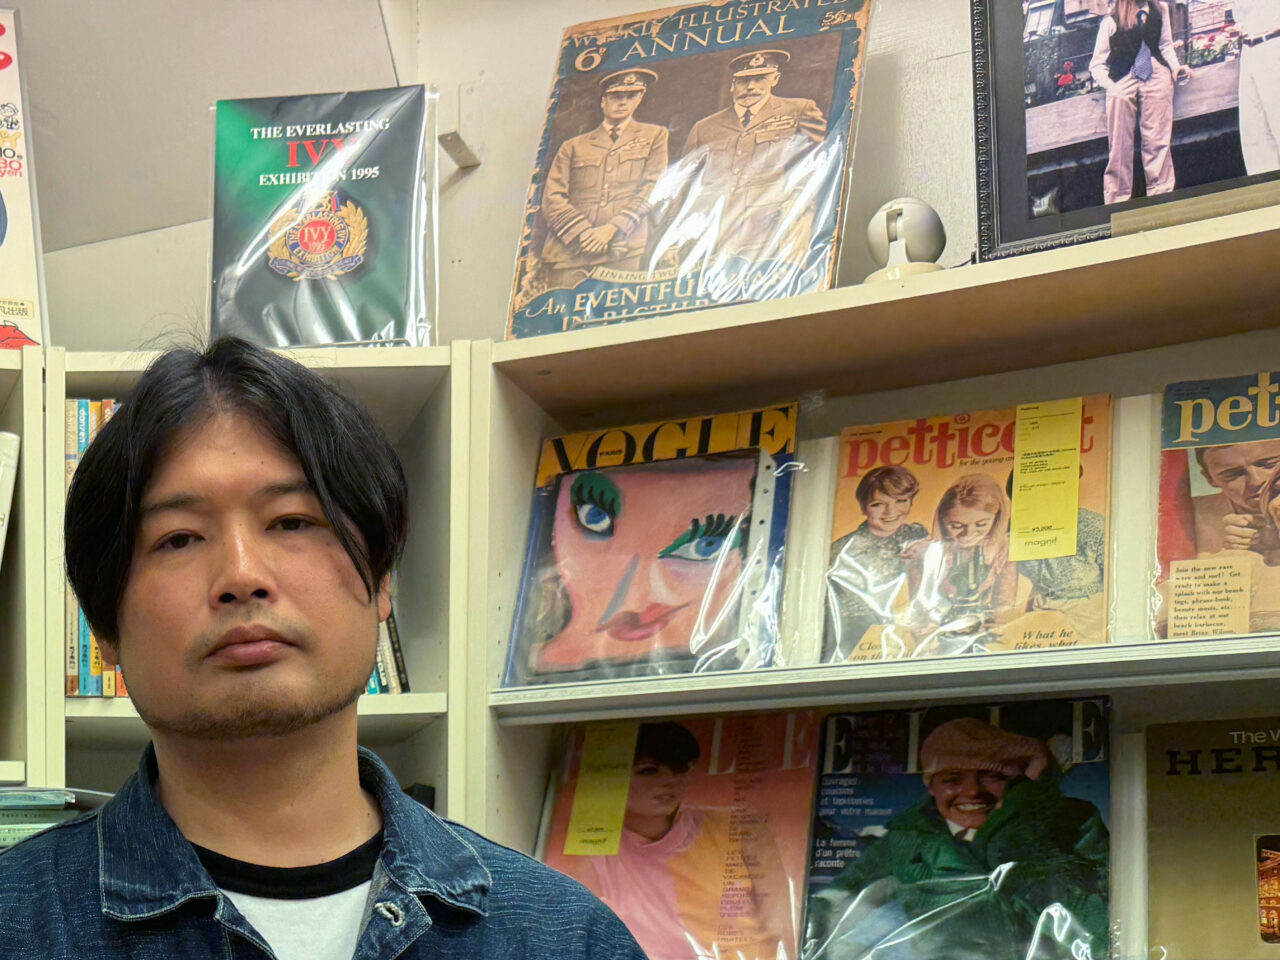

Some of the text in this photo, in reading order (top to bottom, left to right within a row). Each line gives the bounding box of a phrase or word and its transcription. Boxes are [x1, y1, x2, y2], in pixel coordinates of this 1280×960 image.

[620, 14, 795, 62] ANNUAL
[250, 119, 390, 139] THE EVERLASTING
[351, 166, 380, 180] 1995
[304, 226, 332, 243] IVY
[525, 298, 567, 317] An
[1022, 629, 1073, 639] What he
[1229, 730, 1266, 744] The
[816, 838, 857, 848] La femme
[815, 848, 832, 858] d'un
